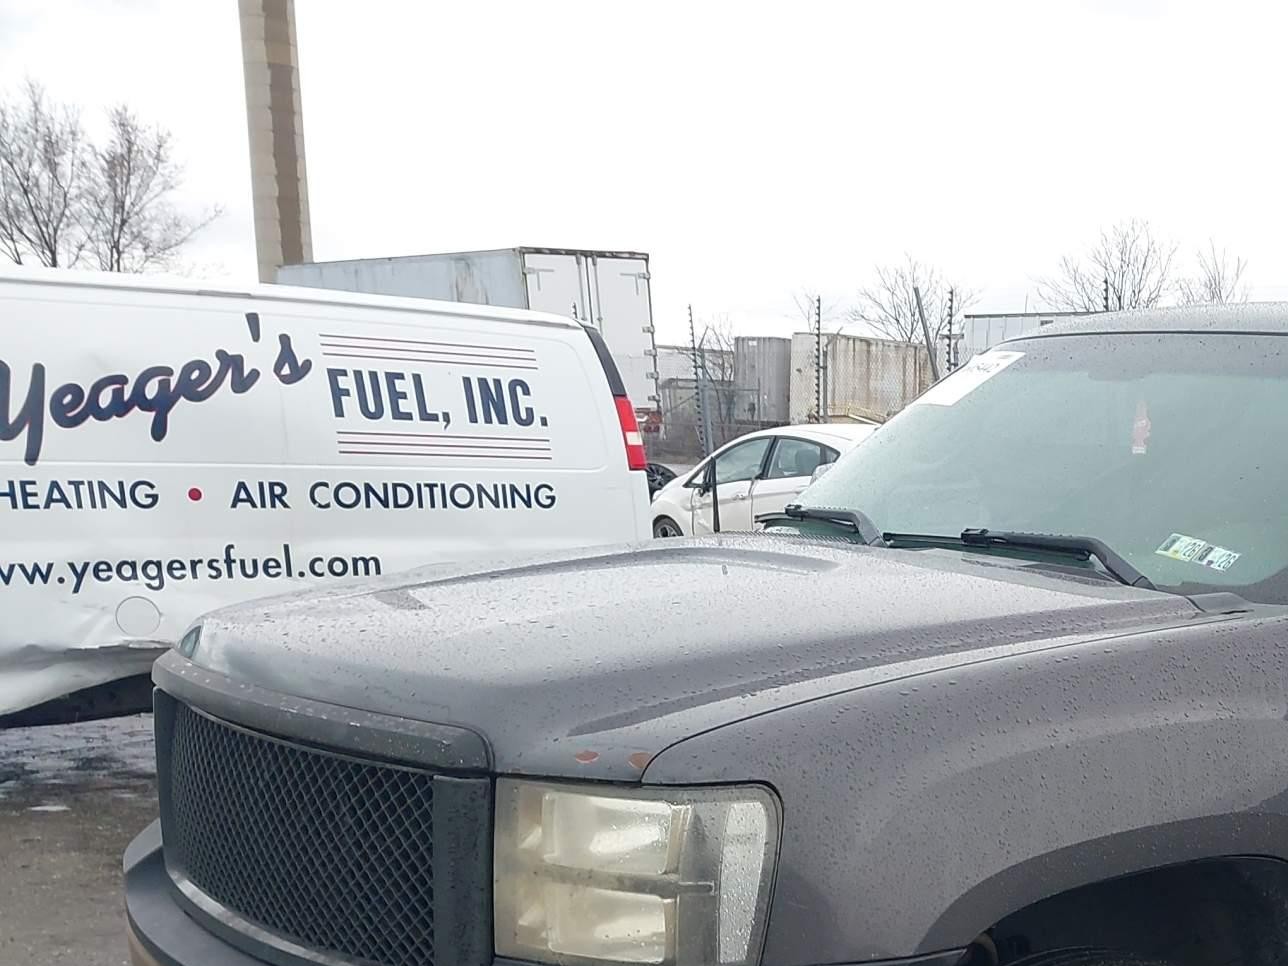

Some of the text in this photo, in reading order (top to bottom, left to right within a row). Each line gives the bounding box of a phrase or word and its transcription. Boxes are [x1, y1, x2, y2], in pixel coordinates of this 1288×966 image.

[0, 312, 312, 466] Yeager's
[326, 367, 549, 430] FUEL, INC.
[230, 480, 292, 509] AIR
[309, 481, 557, 510] CONDITIONING
